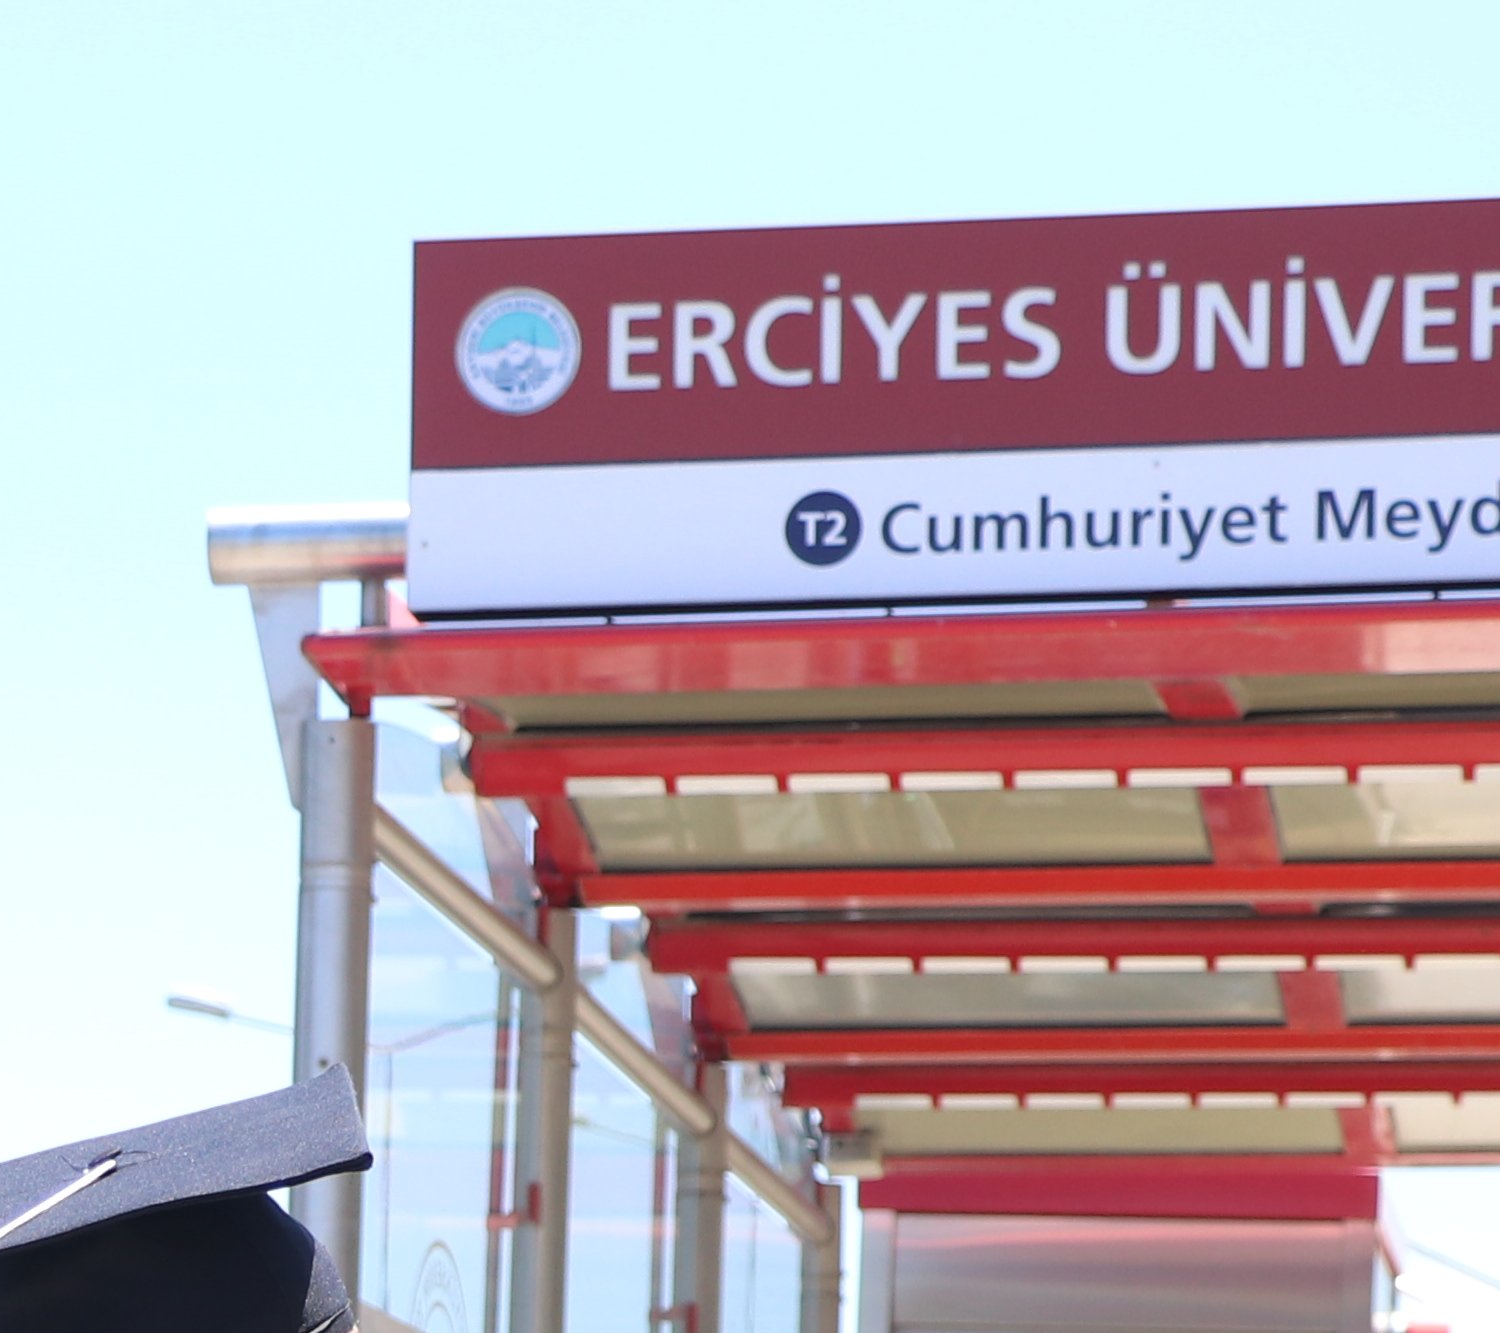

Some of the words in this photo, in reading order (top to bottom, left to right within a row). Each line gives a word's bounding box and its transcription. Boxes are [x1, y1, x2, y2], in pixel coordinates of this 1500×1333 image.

[608, 274, 1062, 391] ERCİYES
[797, 509, 848, 549] T2
[880, 491, 1288, 562] Cumhuriyet
